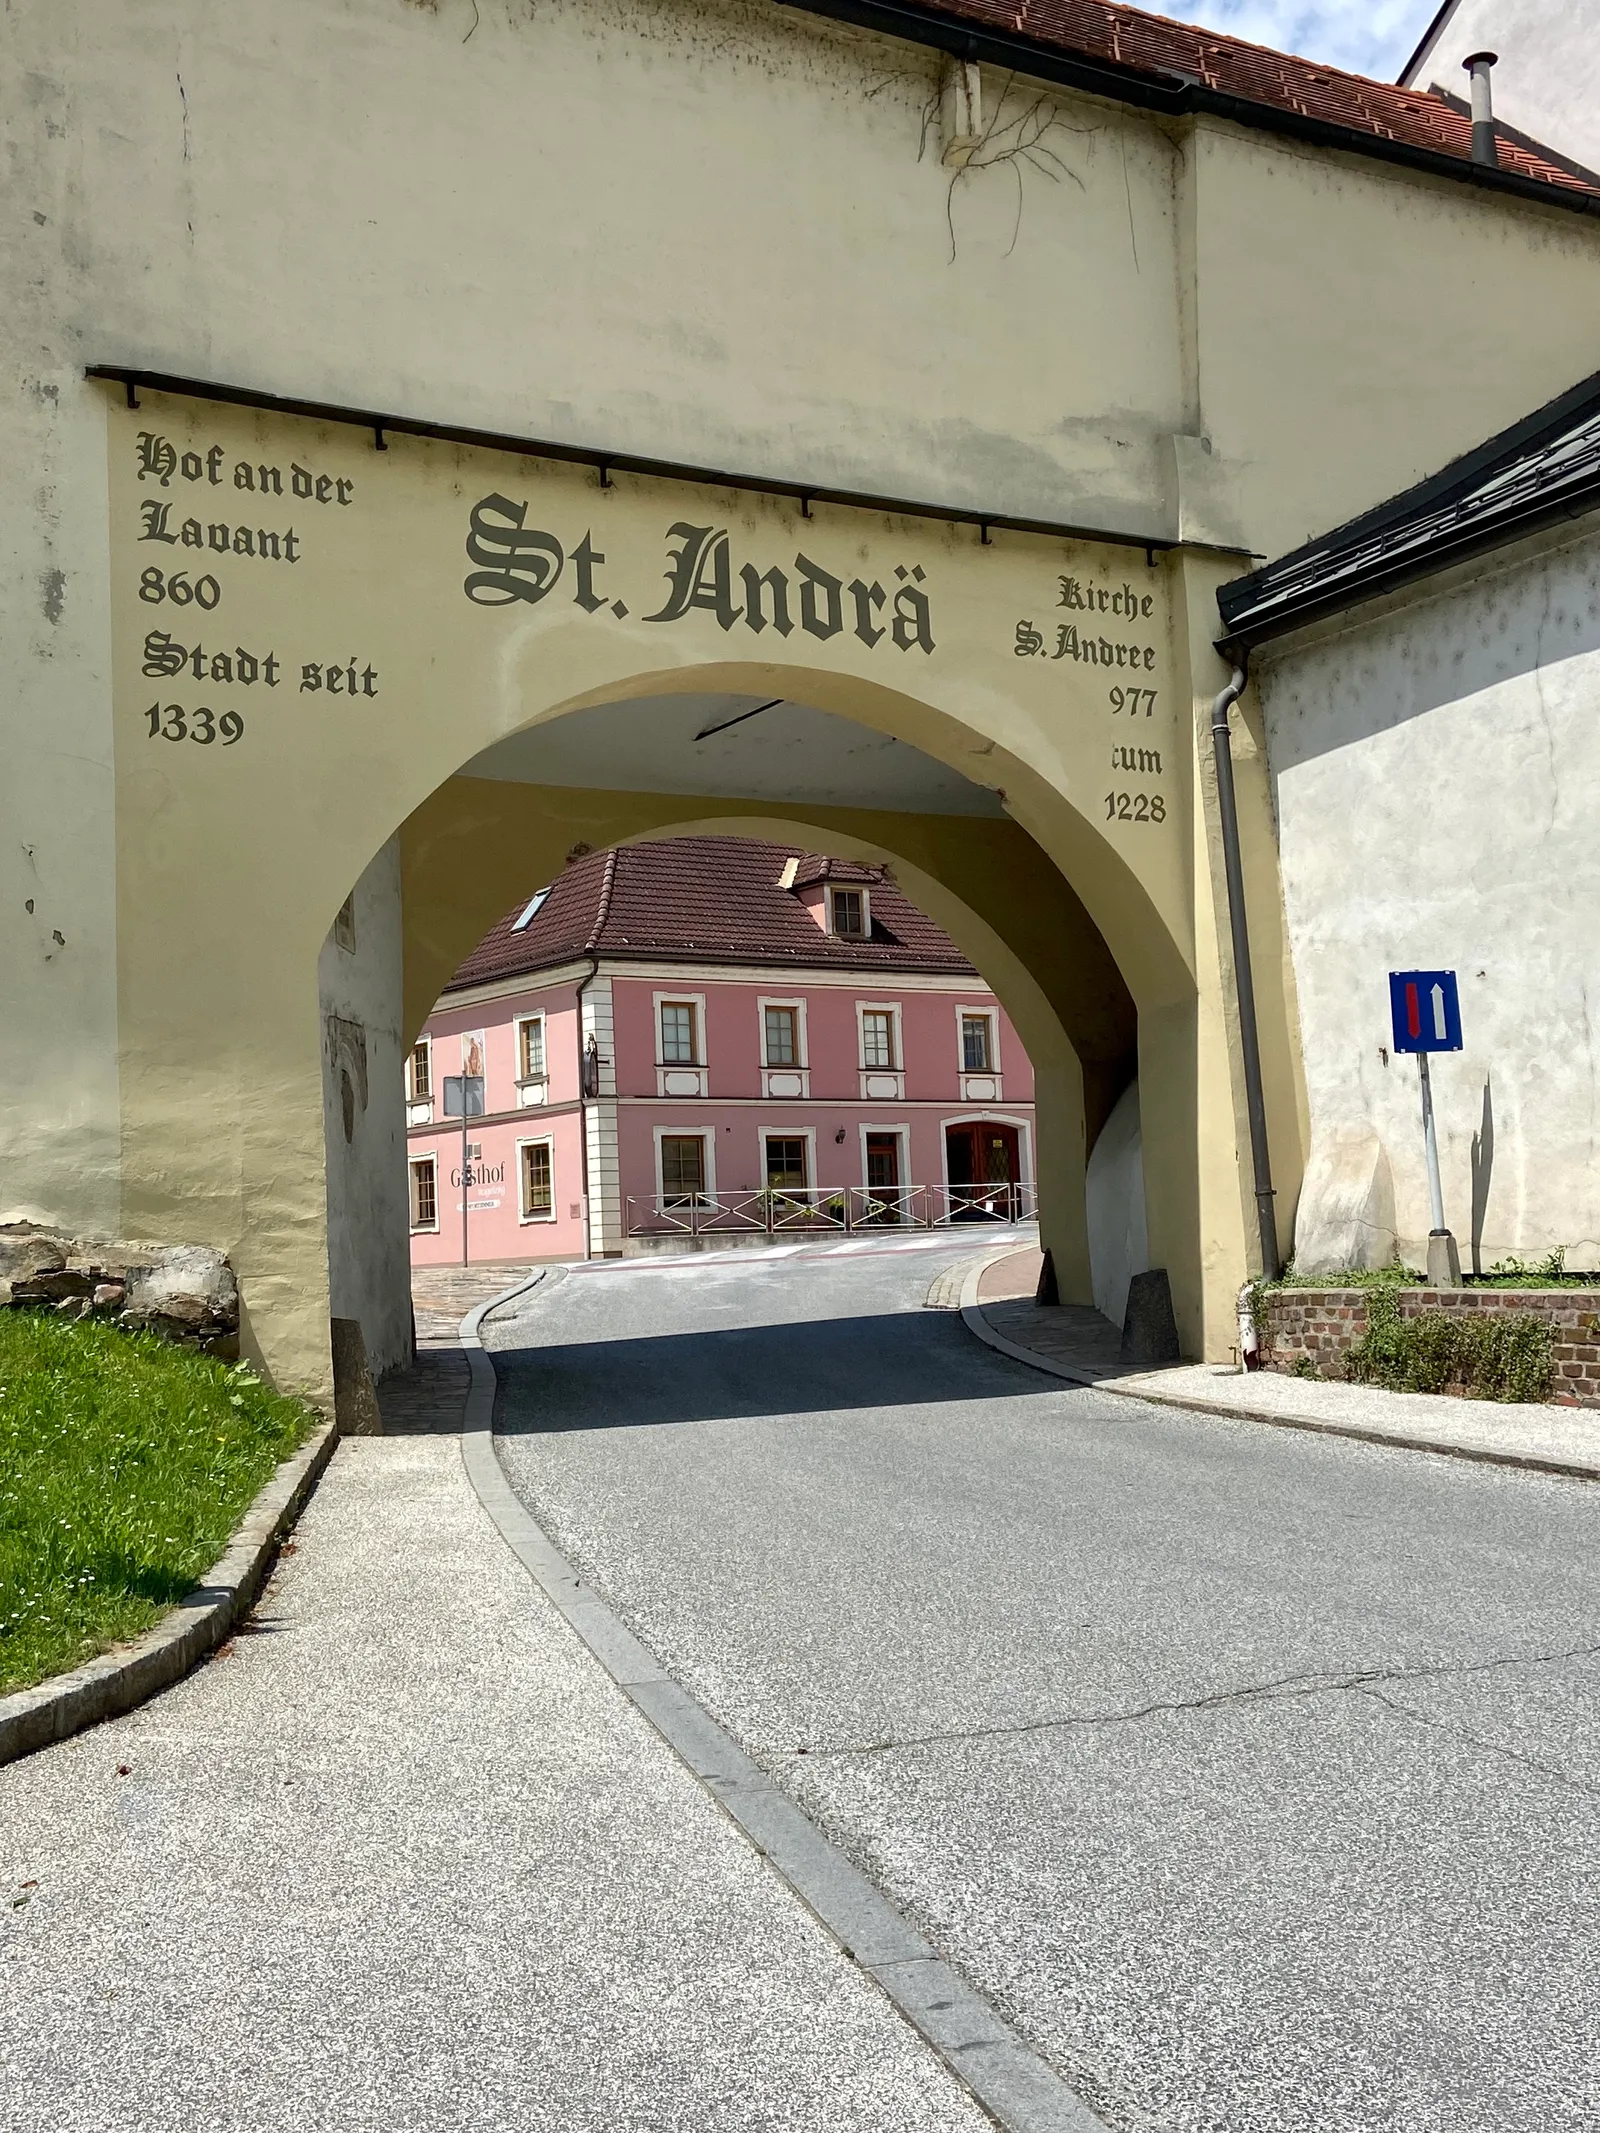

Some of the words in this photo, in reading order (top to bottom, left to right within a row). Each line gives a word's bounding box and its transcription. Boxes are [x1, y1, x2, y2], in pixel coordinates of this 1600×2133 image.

[135, 431, 226, 488] Hof
[232, 461, 285, 497] an
[290, 462, 355, 507] der
[136, 499, 301, 564] Lavant
[138, 566, 221, 611] 860
[462, 491, 631, 619] St.
[640, 521, 937, 656] Andrä
[1055, 574, 1154, 623] Kirche
[141, 629, 280, 688] Stadt
[299, 656, 379, 699] seit
[143, 701, 244, 746] 1339
[1108, 685, 1158, 718] 977
[1104, 791, 1167, 824] 1228
[450, 1160, 506, 1188] Gsthof
